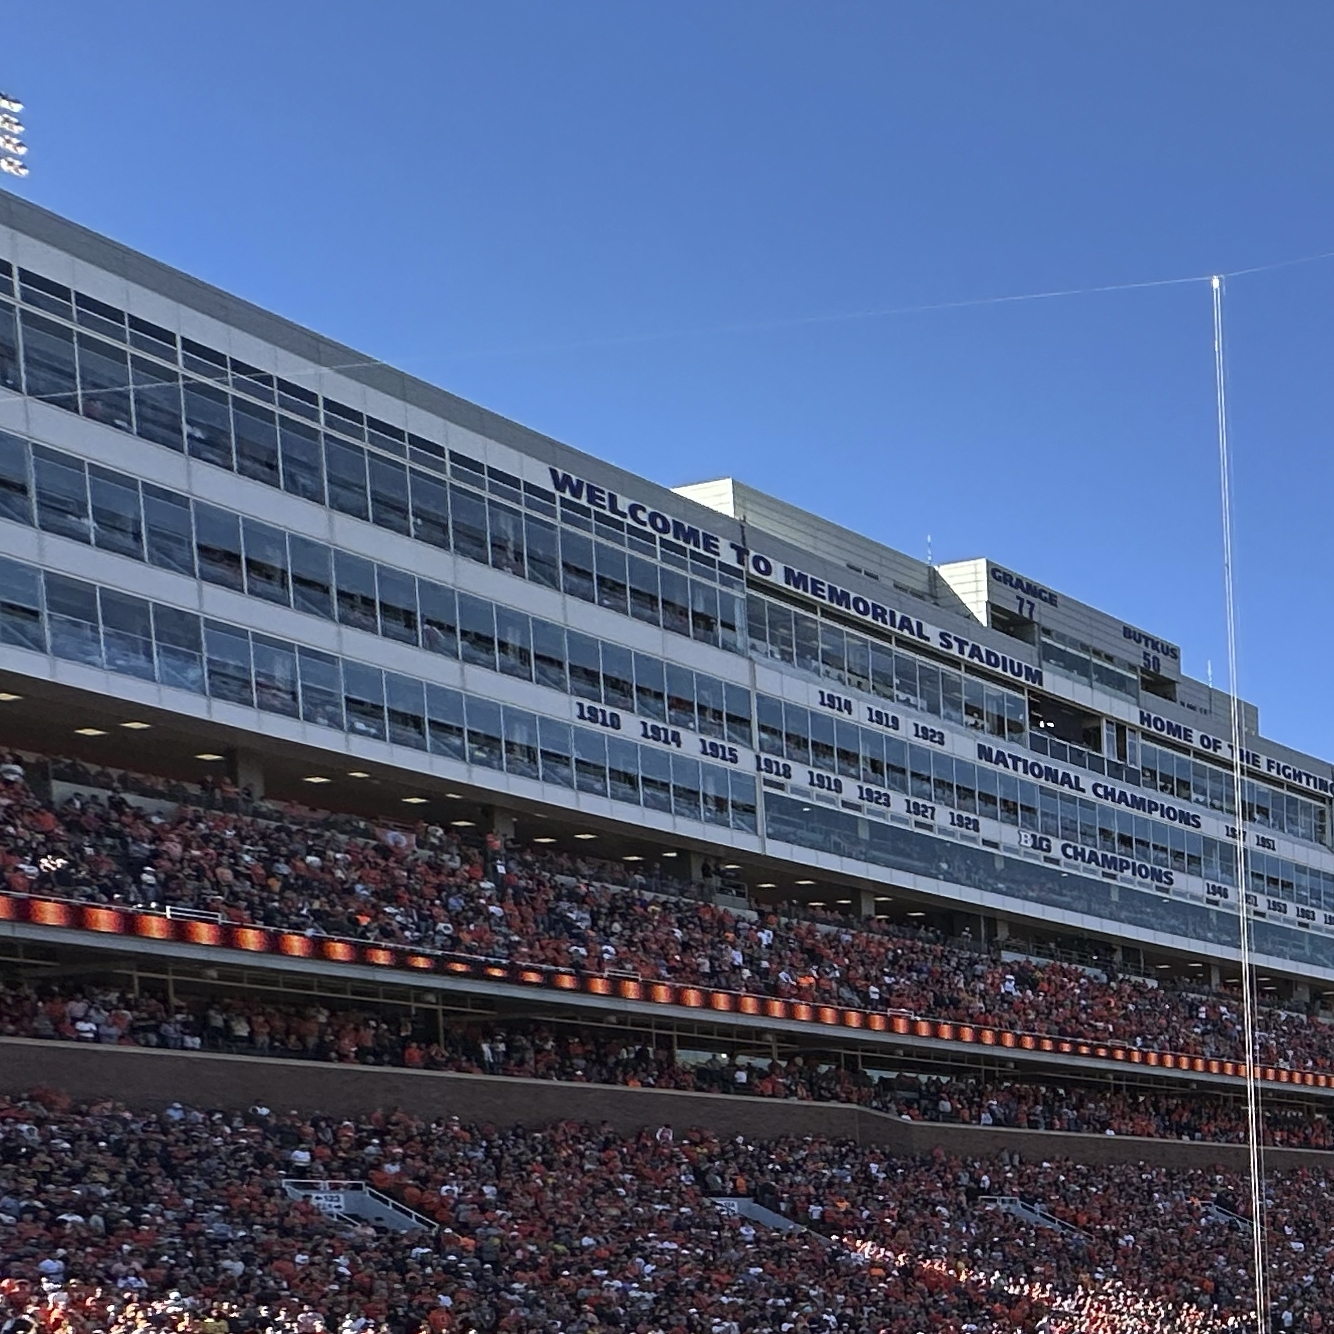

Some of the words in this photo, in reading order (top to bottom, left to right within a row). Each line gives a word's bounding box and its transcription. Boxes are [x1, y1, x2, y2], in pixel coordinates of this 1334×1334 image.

[548, 466, 720, 557] WELCOME
[730, 542, 772, 577] TO
[784, 565, 930, 642] MEMORIAL
[939, 631, 1044, 687] STADIUM
[990, 566, 1058, 608] GRANGE
[1015, 595, 1035, 621] 77
[1122, 625, 1178, 660] BUTKUS
[1142, 651, 1161, 674] 50
[1139, 710, 1194, 744] HOME
[1199, 734, 1223, 753] OF
[818, 690, 853, 716] 1914
[867, 706, 900, 731] 1919
[913, 722, 946, 746] 1923
[977, 742, 1086, 794] NATIONAL
[1092, 781, 1202, 829] CHAMPIONS
[575, 701, 622, 730] 1910
[640, 720, 682, 748] 1914
[699, 737, 739, 764] 1915
[755, 754, 792, 780] 1918
[808, 770, 843, 794] 1919
[857, 784, 891, 808] 1923
[905, 798, 936, 821] 1927
[1061, 842, 1175, 886] CHAMPIONS
